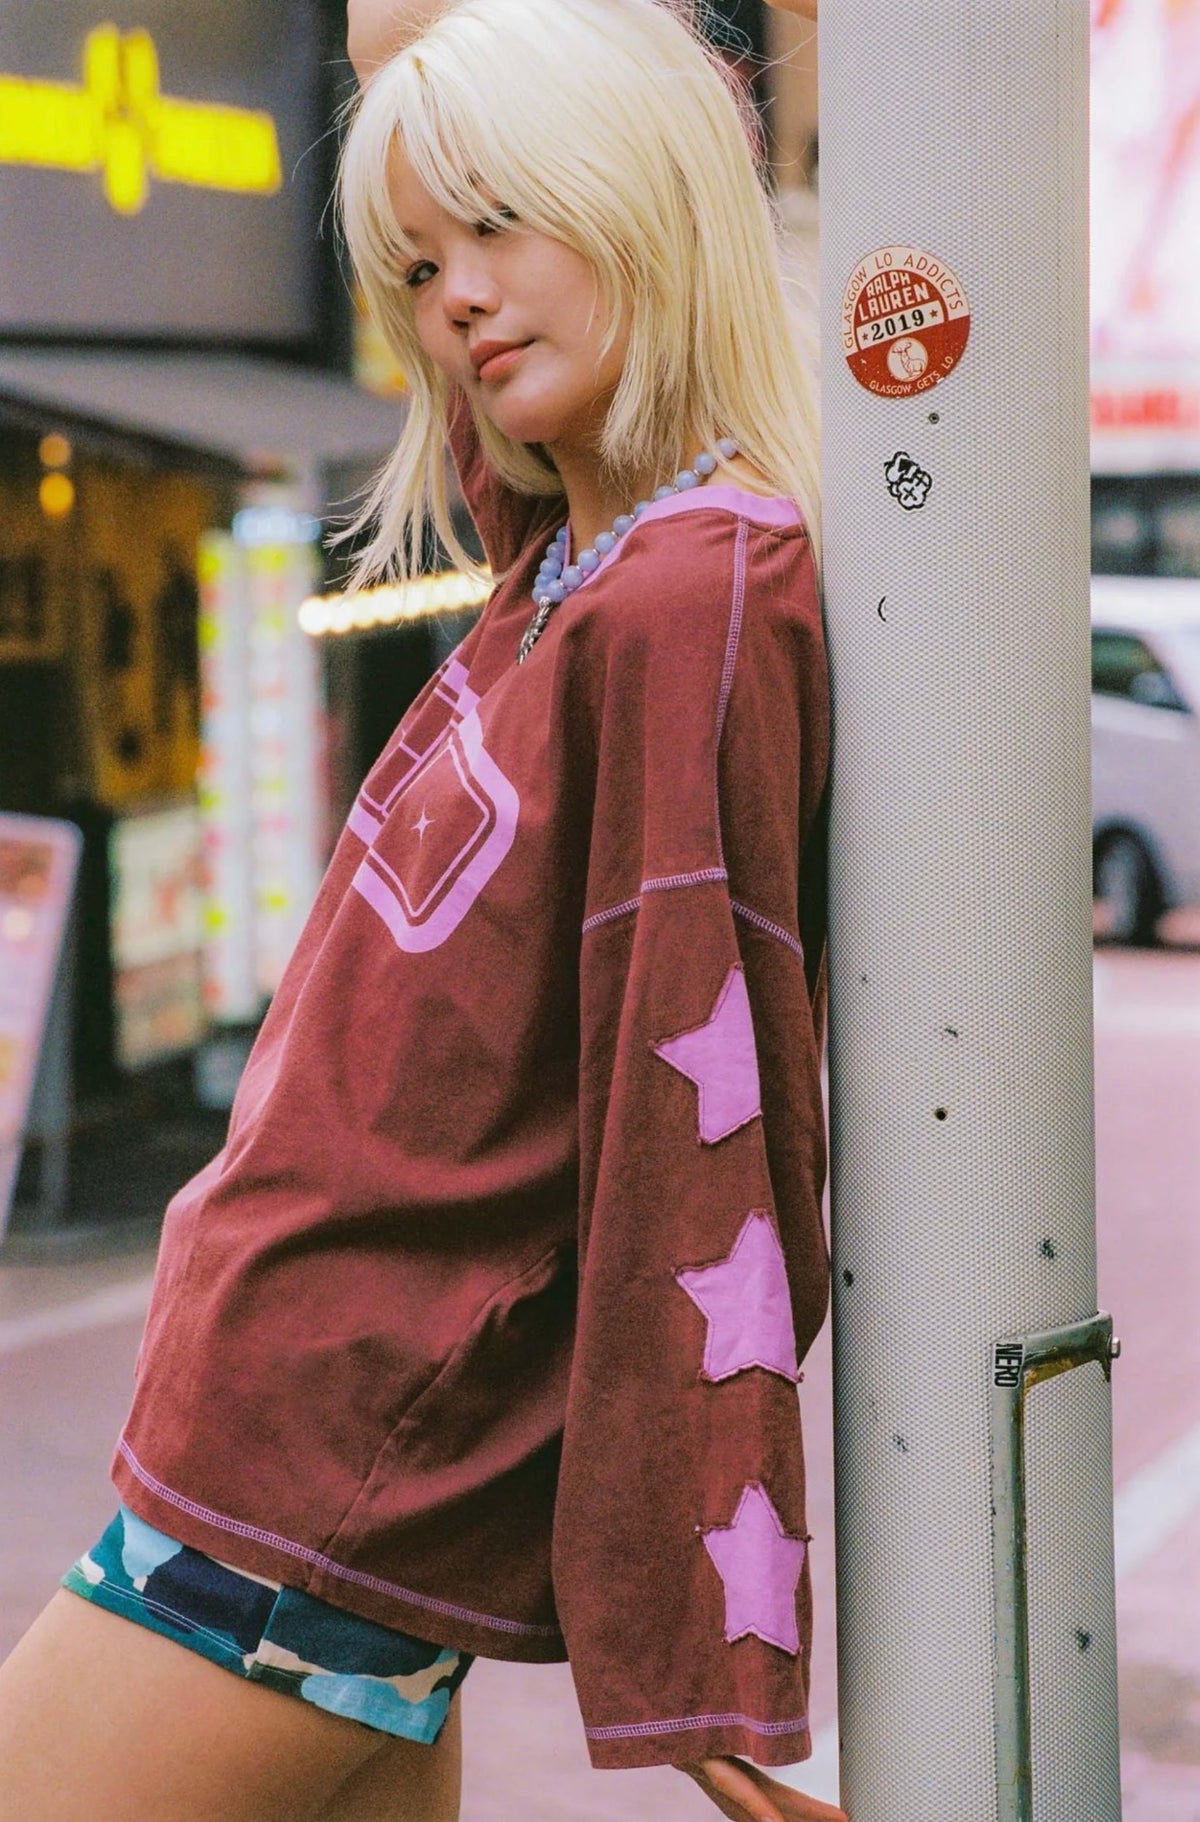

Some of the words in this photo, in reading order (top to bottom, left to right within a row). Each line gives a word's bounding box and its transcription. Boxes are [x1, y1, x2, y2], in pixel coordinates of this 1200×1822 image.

[844, 266, 867, 349] GLASGOW
[875, 252, 893, 269] LO
[904, 253, 964, 311] ADDICTS
[858, 282, 930, 322] LAUREN
[866, 271, 910, 298] RALPH
[871, 309, 925, 341] 2019
[869, 379, 912, 395] GLASGOW
[917, 371, 941, 389] GETS
[942, 355, 954, 369] LO
